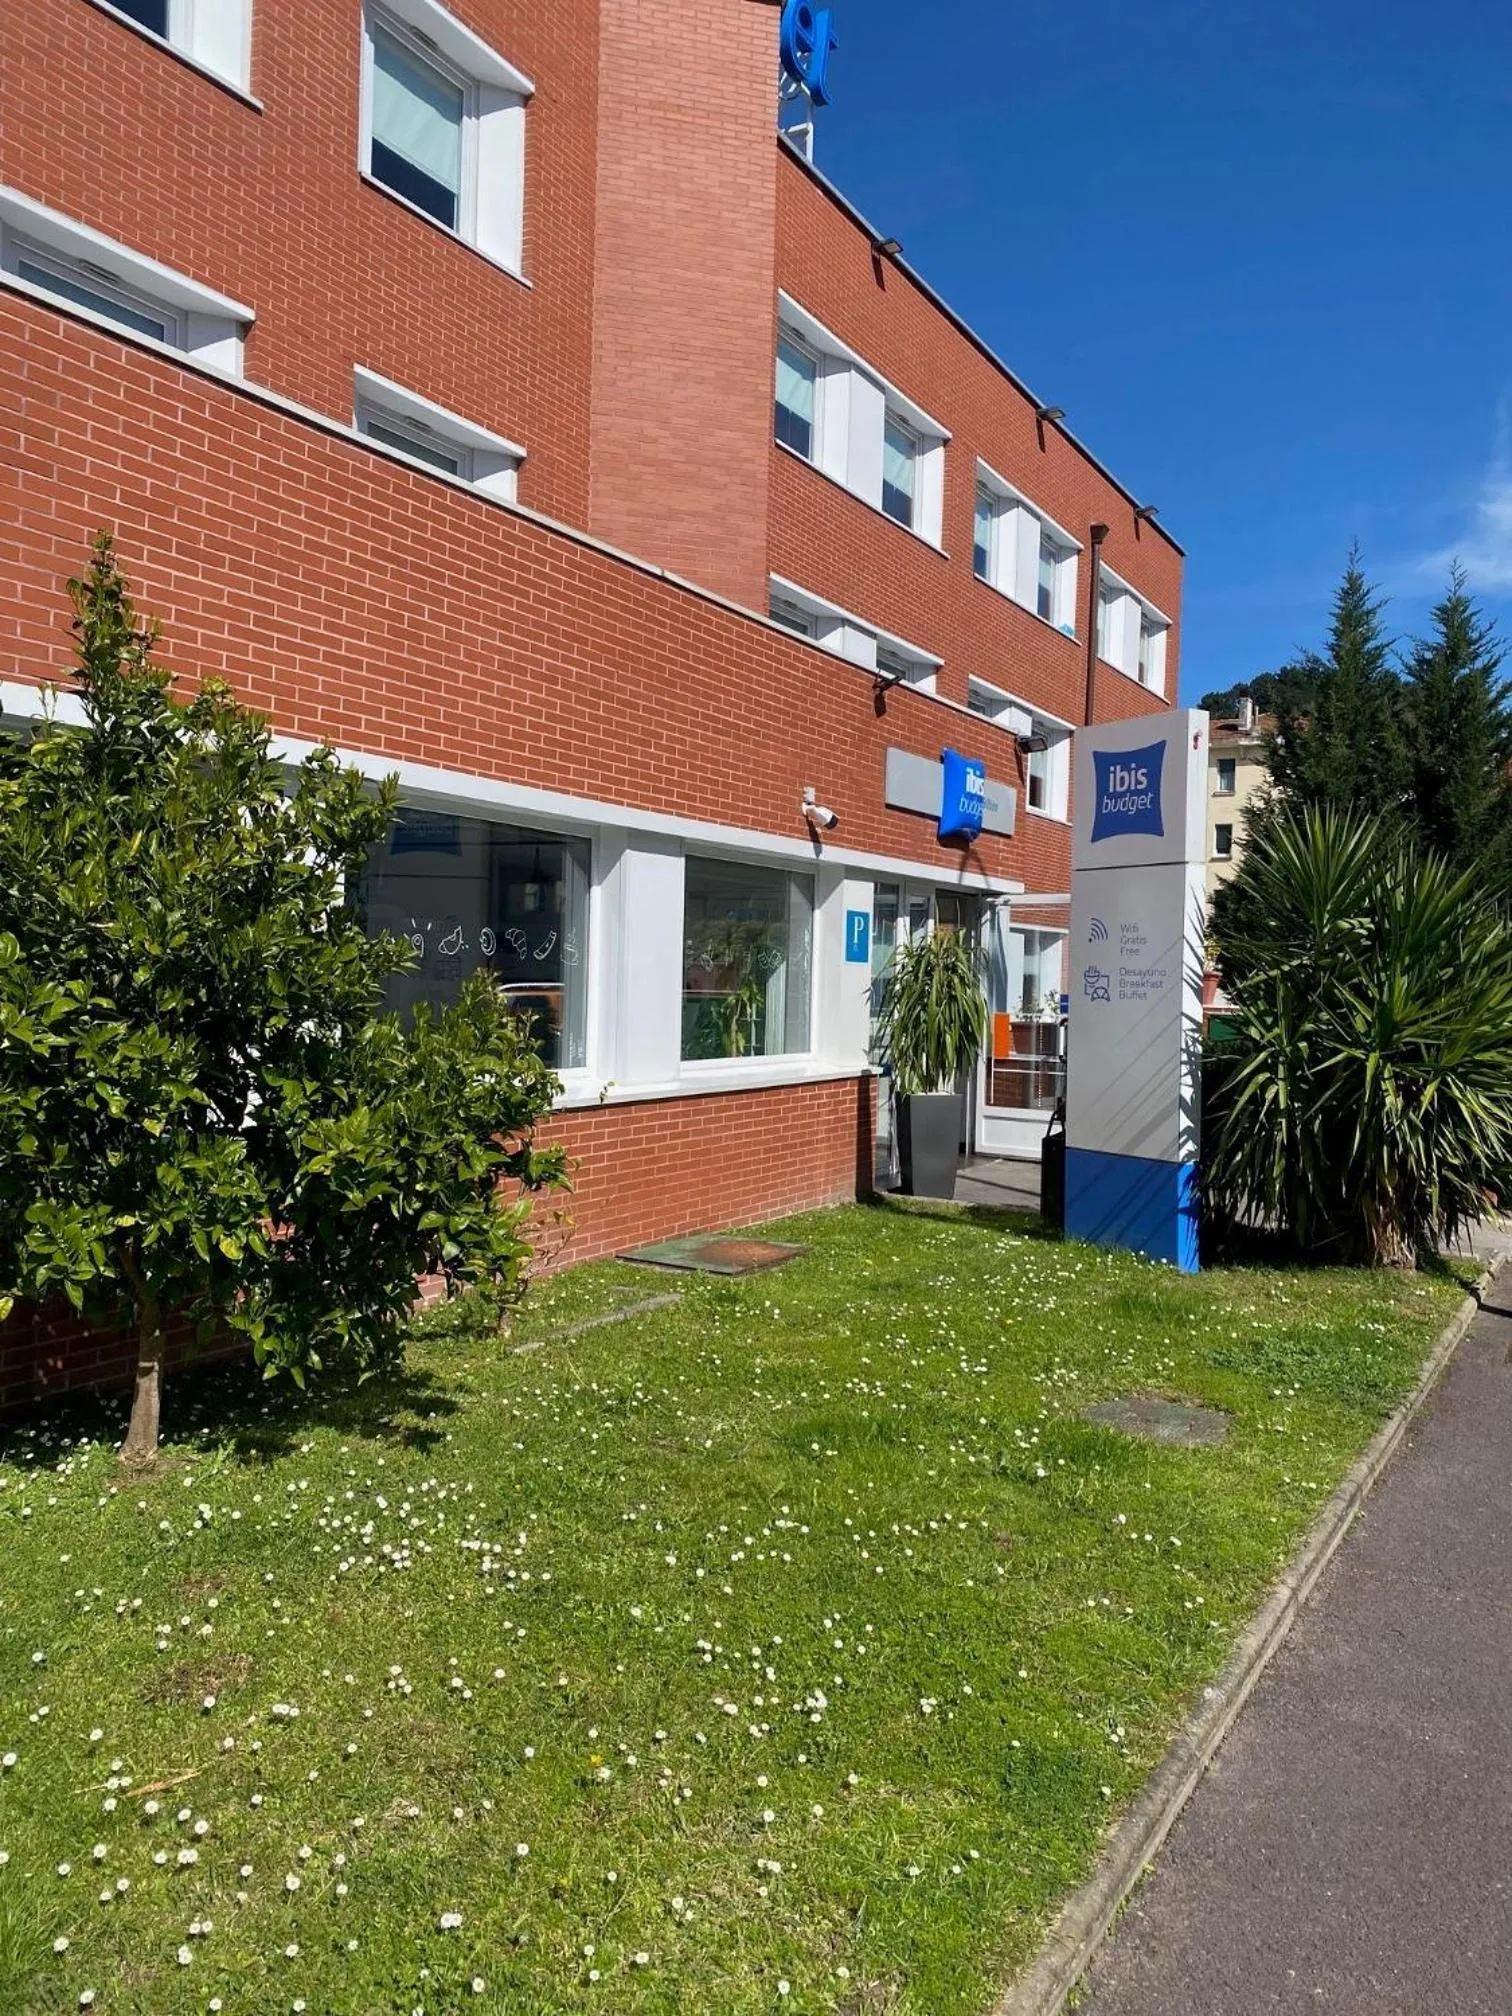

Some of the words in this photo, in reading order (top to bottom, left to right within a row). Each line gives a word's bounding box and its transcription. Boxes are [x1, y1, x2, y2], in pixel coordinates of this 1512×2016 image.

[1109, 763, 1148, 793] ibis
[1102, 792, 1154, 815] budget
[853, 916, 864, 943] P
[1120, 936, 1147, 945] Gratis
[1120, 946, 1141, 956] Free
[1119, 967, 1167, 977] Desayuno
[1119, 979, 1163, 989] Breakfast
[1119, 990, 1147, 1000] Buffet
